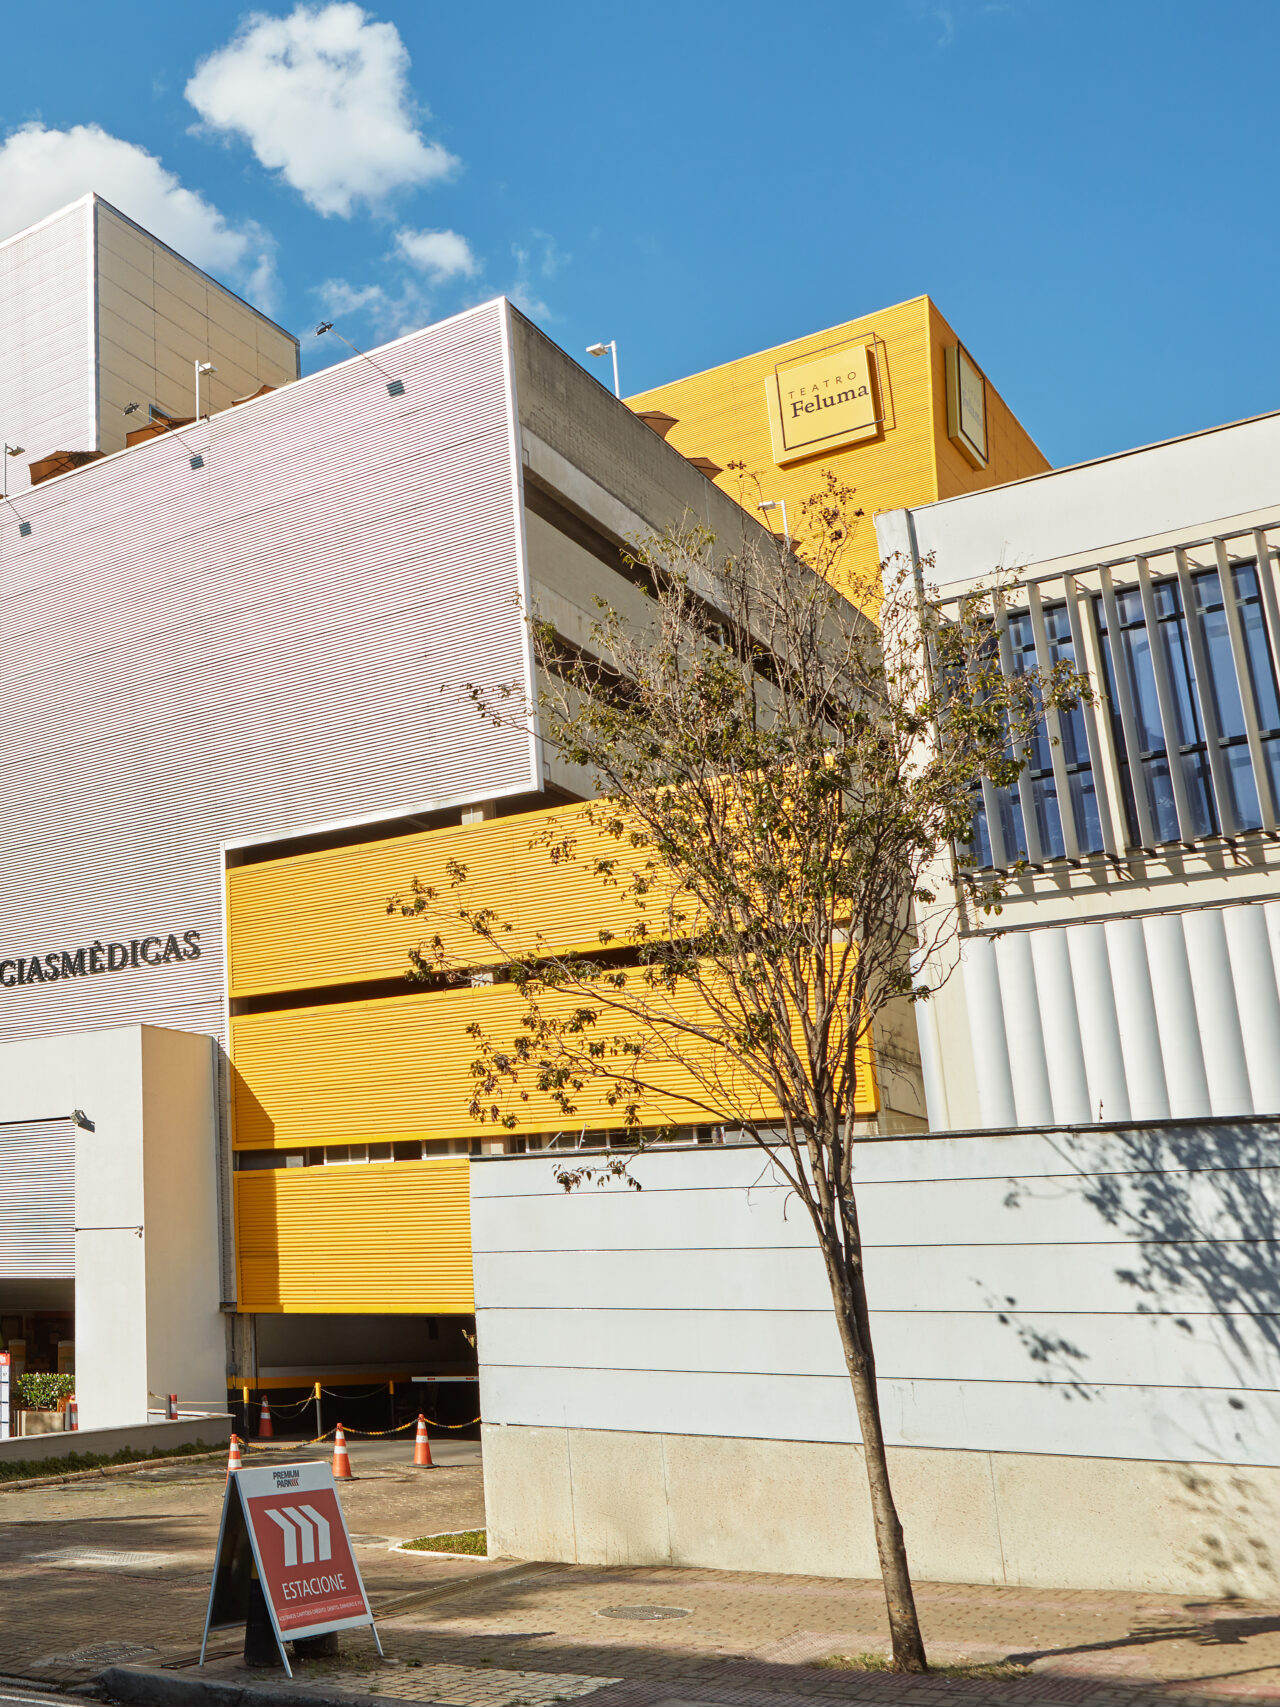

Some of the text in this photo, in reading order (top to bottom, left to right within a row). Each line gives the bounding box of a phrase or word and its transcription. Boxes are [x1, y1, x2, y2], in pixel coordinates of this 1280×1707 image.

[788, 371, 856, 399] TEATRO
[790, 385, 869, 418] Feluma
[273, 1469, 300, 1480] PREMIUM
[276, 1478, 292, 1489] PARK
[282, 1573, 347, 1600] ESTACIONE
